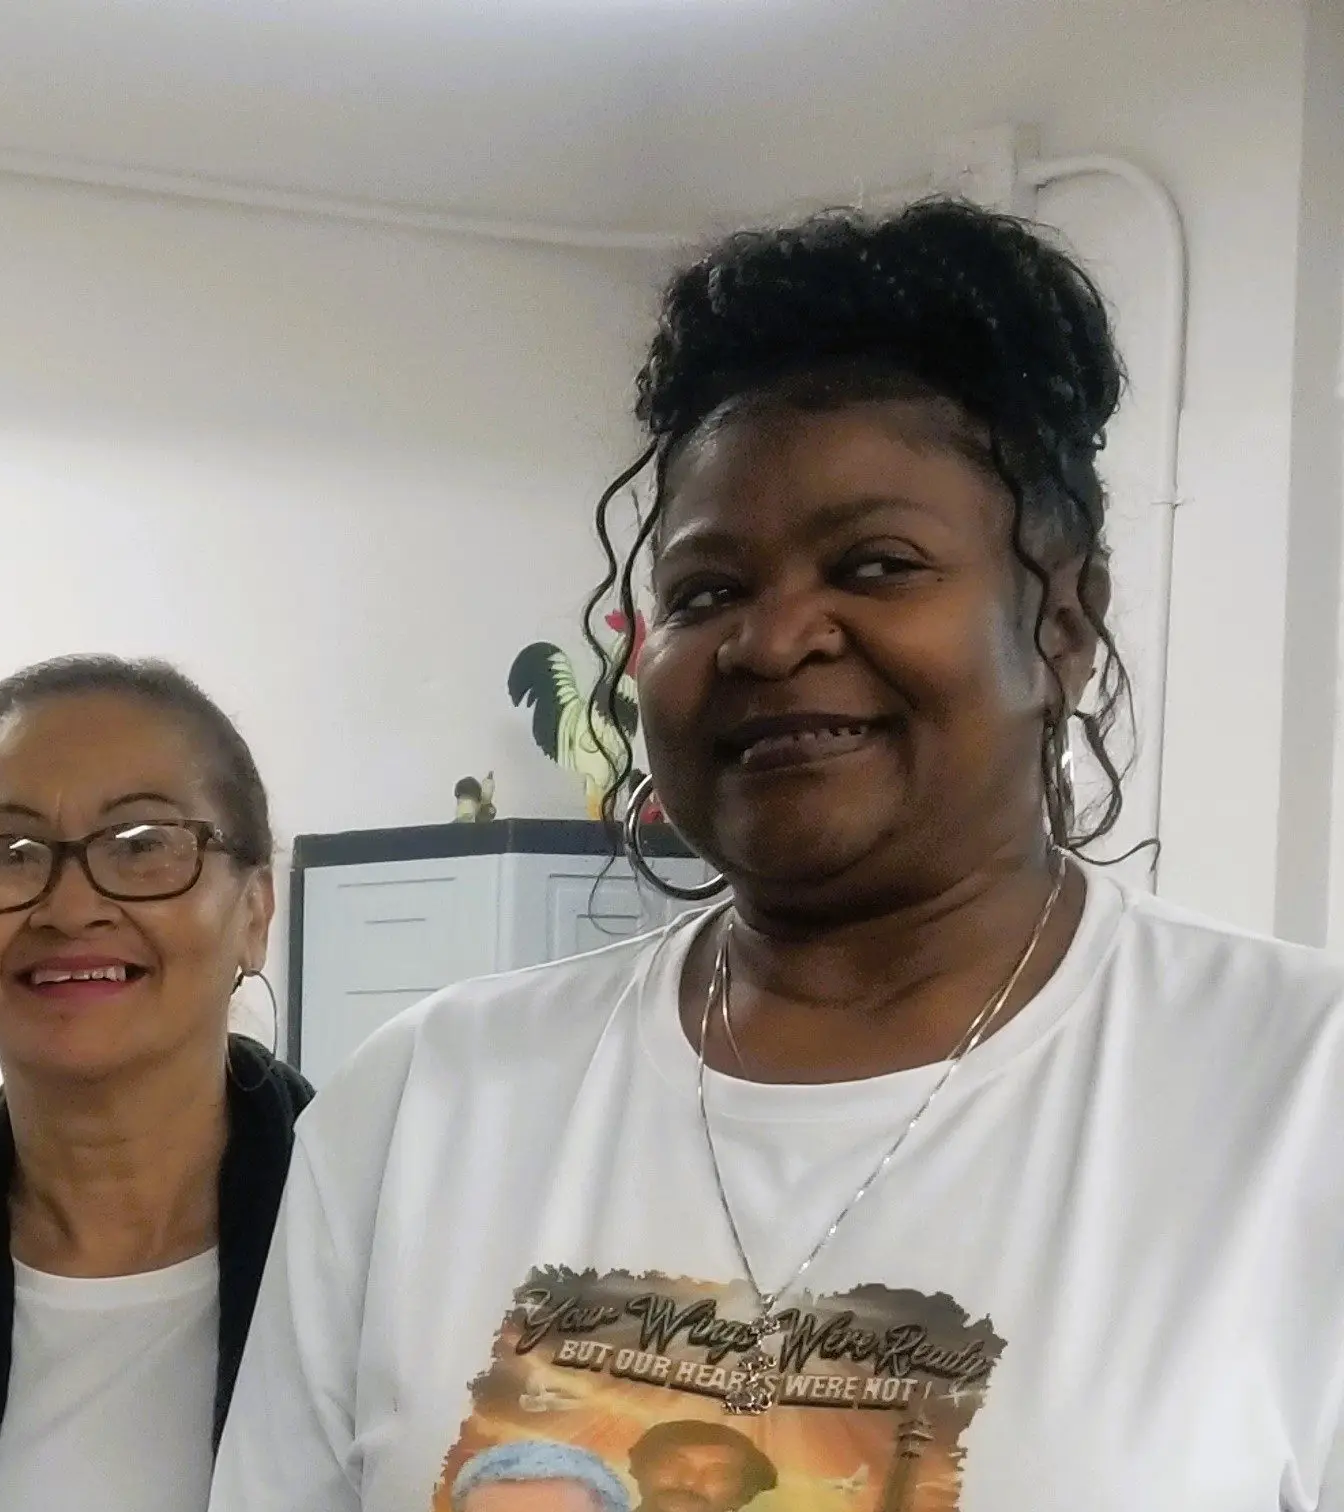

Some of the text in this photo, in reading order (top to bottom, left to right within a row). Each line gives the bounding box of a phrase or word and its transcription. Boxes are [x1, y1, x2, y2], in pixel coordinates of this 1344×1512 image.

[558, 1340, 614, 1366] BUT
[616, 1349, 672, 1380] OUR
[674, 1361, 778, 1398] HEARS
[785, 1374, 861, 1402] WERE
[777, 1307, 882, 1374] Were
